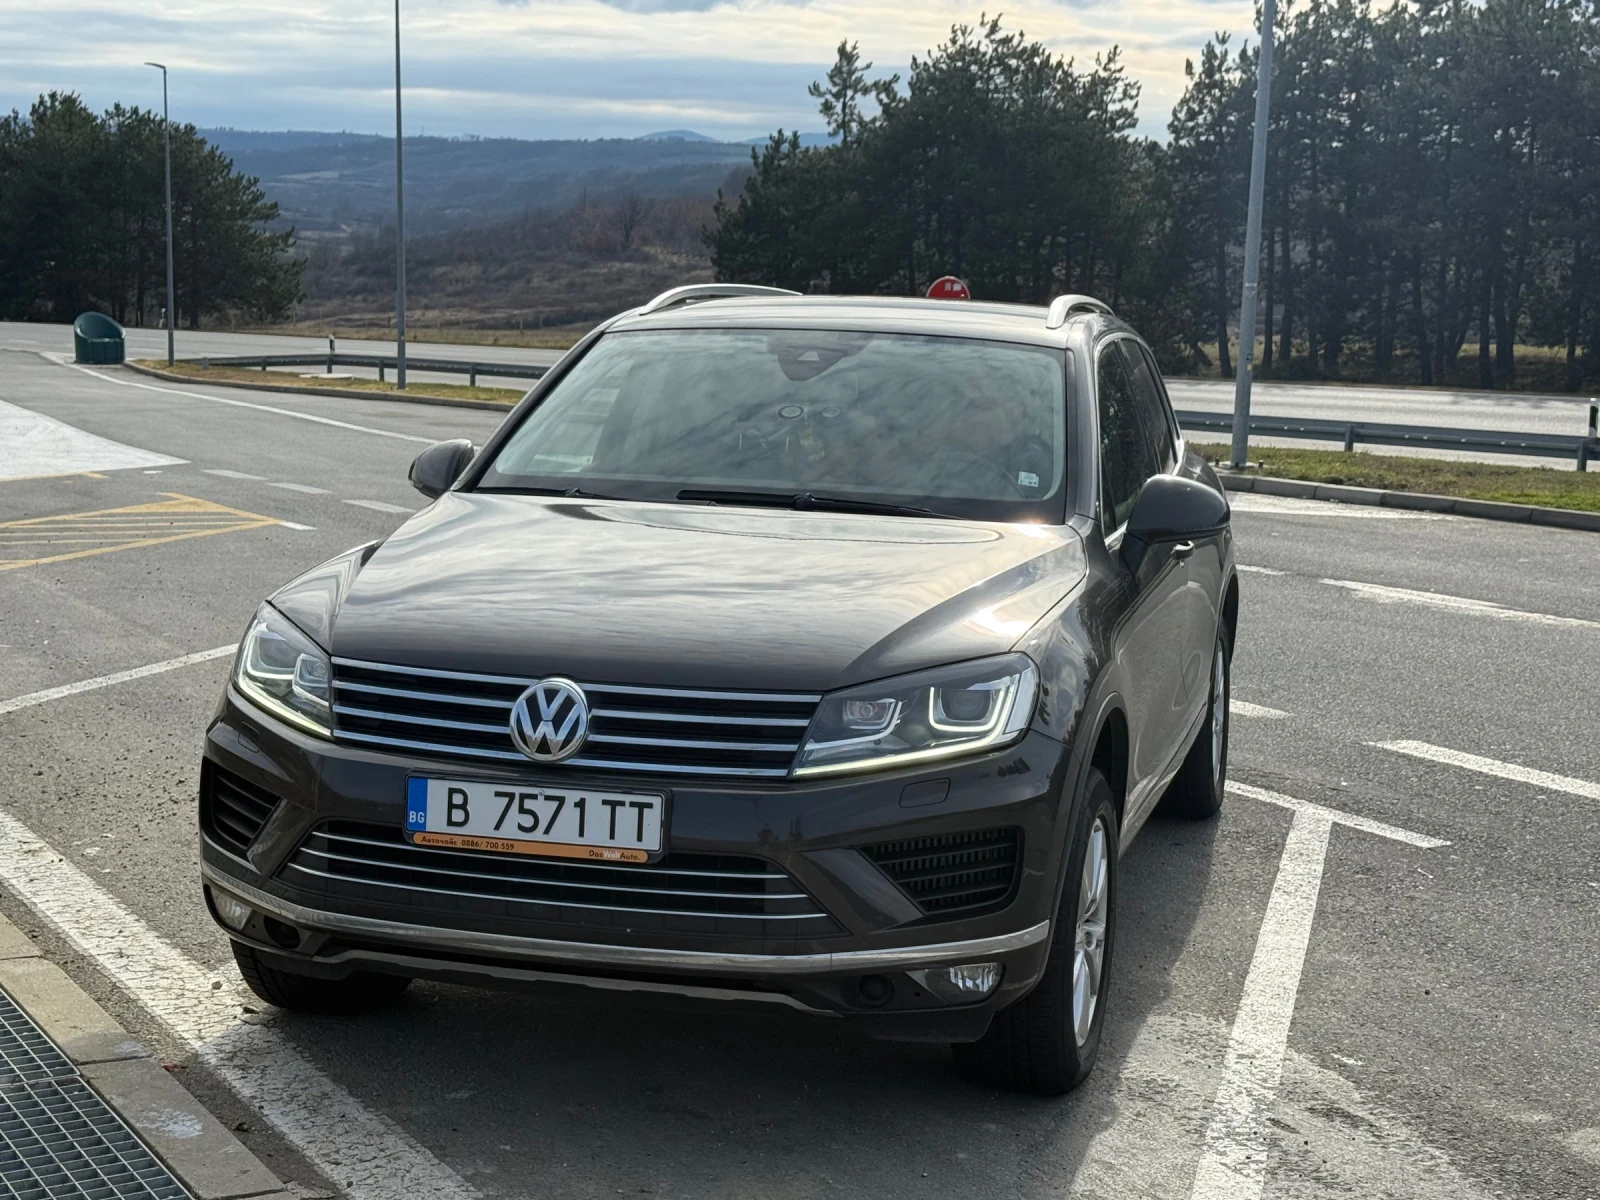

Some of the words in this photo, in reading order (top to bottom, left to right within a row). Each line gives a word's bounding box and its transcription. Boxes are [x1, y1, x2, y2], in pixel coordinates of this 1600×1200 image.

[516, 684, 583, 757] VW
[409, 810, 425, 824] BG
[446, 787, 470, 827] B
[493, 790, 587, 838] 7571
[601, 799, 654, 843] TT
[485, 841, 499, 849] 700
[501, 843, 515, 851] 559
